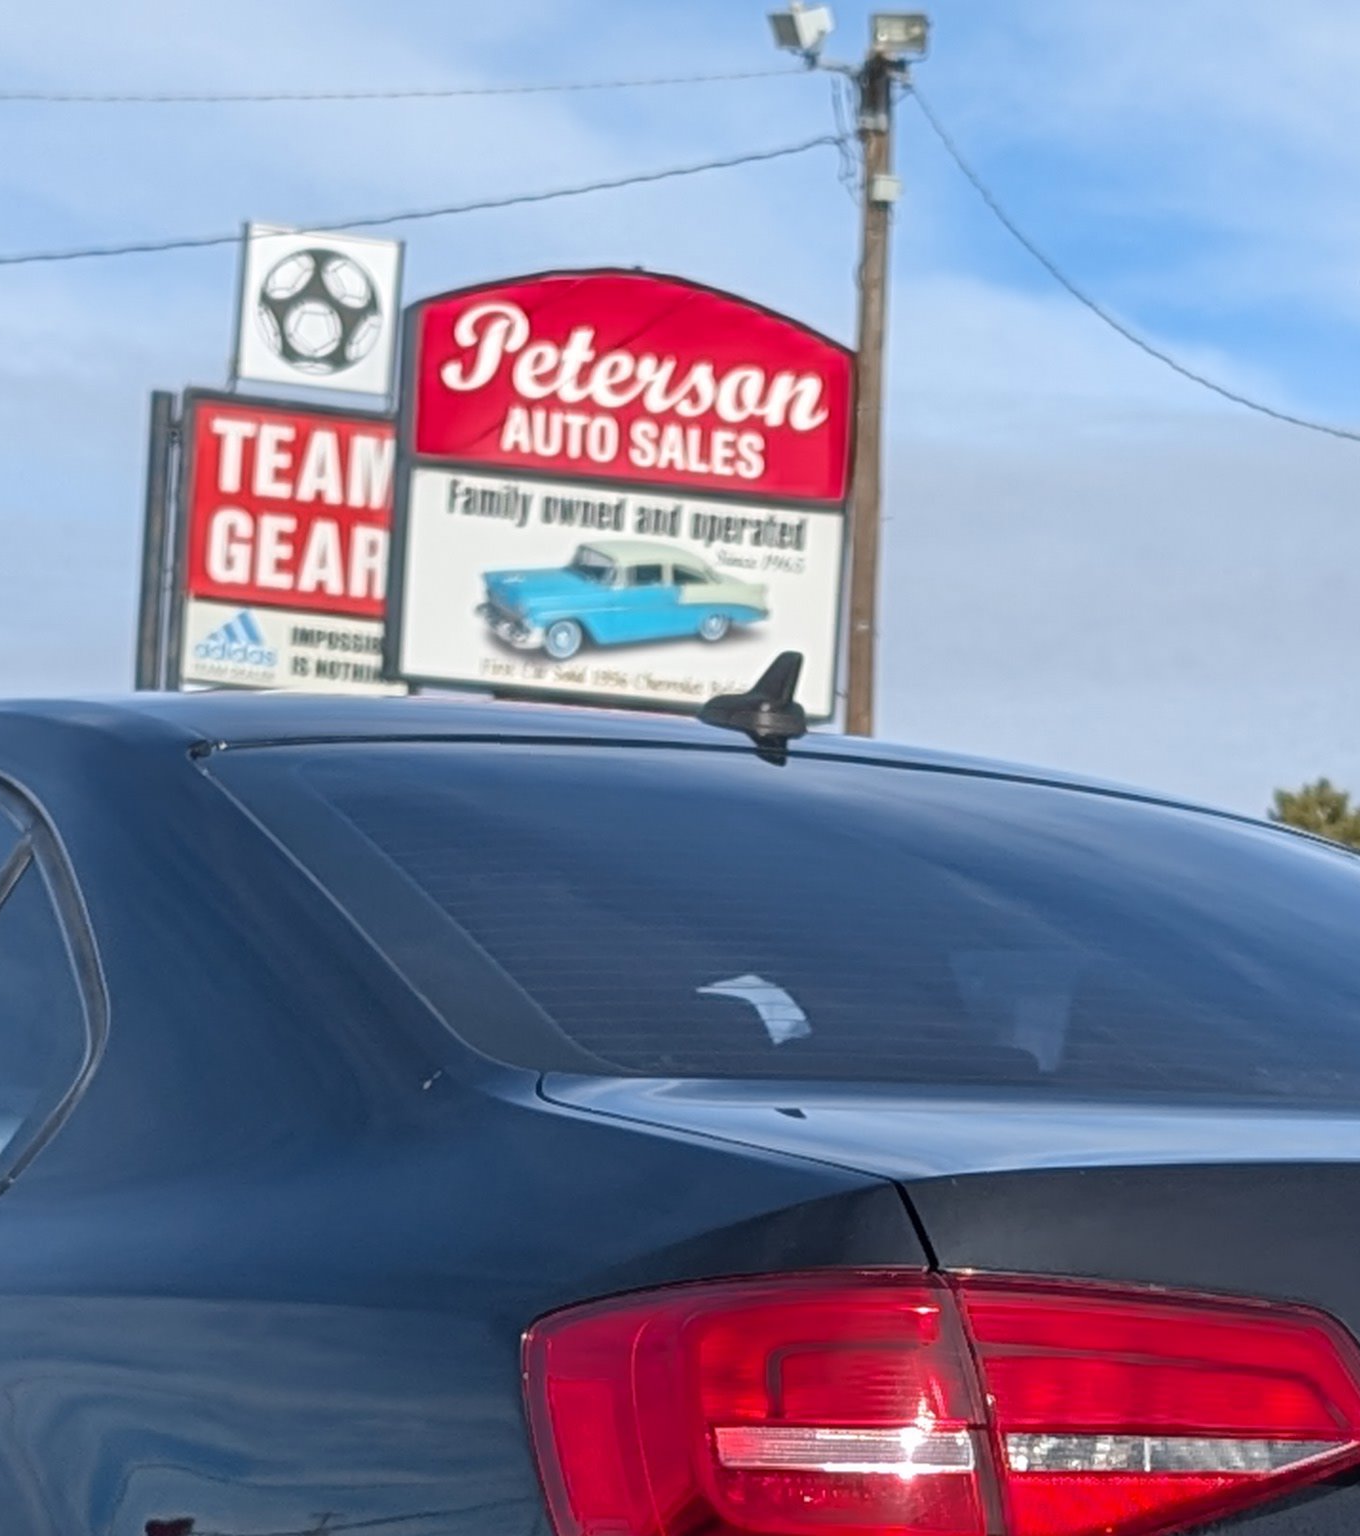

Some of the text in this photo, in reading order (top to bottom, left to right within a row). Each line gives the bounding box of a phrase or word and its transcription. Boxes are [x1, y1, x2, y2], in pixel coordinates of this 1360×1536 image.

[441, 301, 829, 431] Peterson
[210, 417, 396, 510] TEAM
[500, 405, 767, 480] AUTO SALES
[206, 507, 391, 600] GEAR
[447, 477, 807, 552] Family owned and operated
[195, 640, 278, 668] adidas
